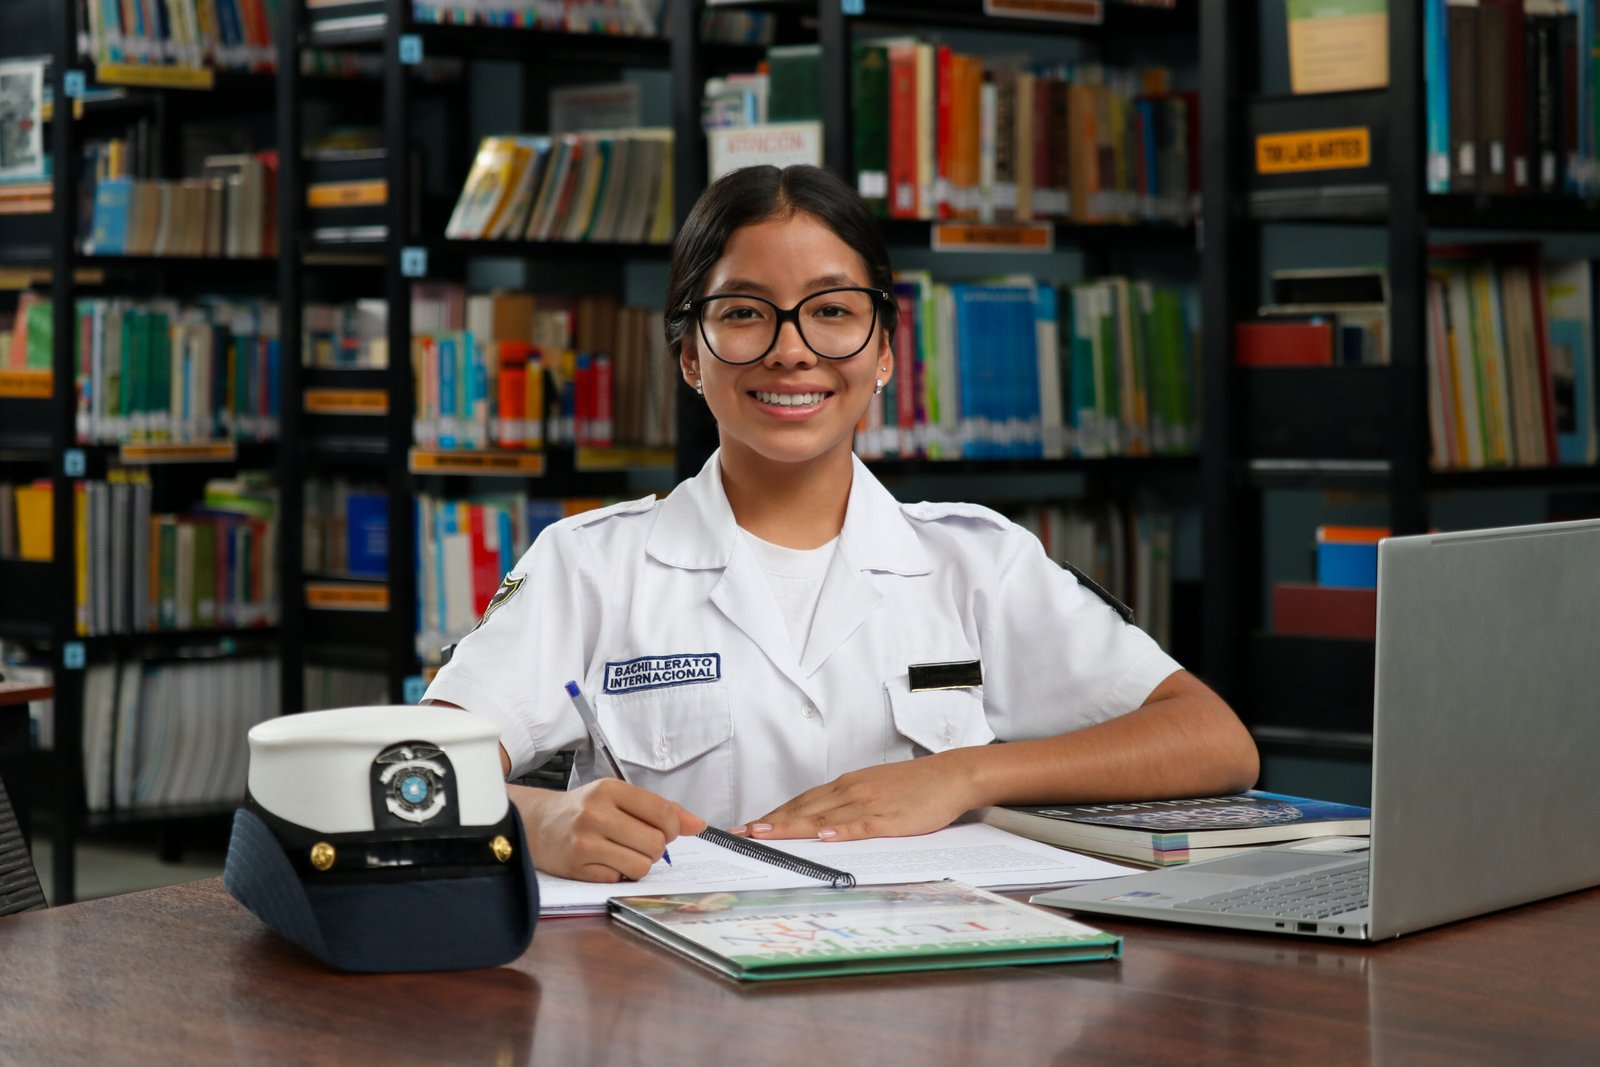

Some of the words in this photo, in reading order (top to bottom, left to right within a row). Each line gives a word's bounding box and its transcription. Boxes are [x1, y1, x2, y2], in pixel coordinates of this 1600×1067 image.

[614, 658, 713, 677] BACHILLERATO
[610, 668, 715, 688] INTERNACIONAL
[1075, 796, 1257, 813] ENGLISH
[680, 914, 799, 926] deporte
